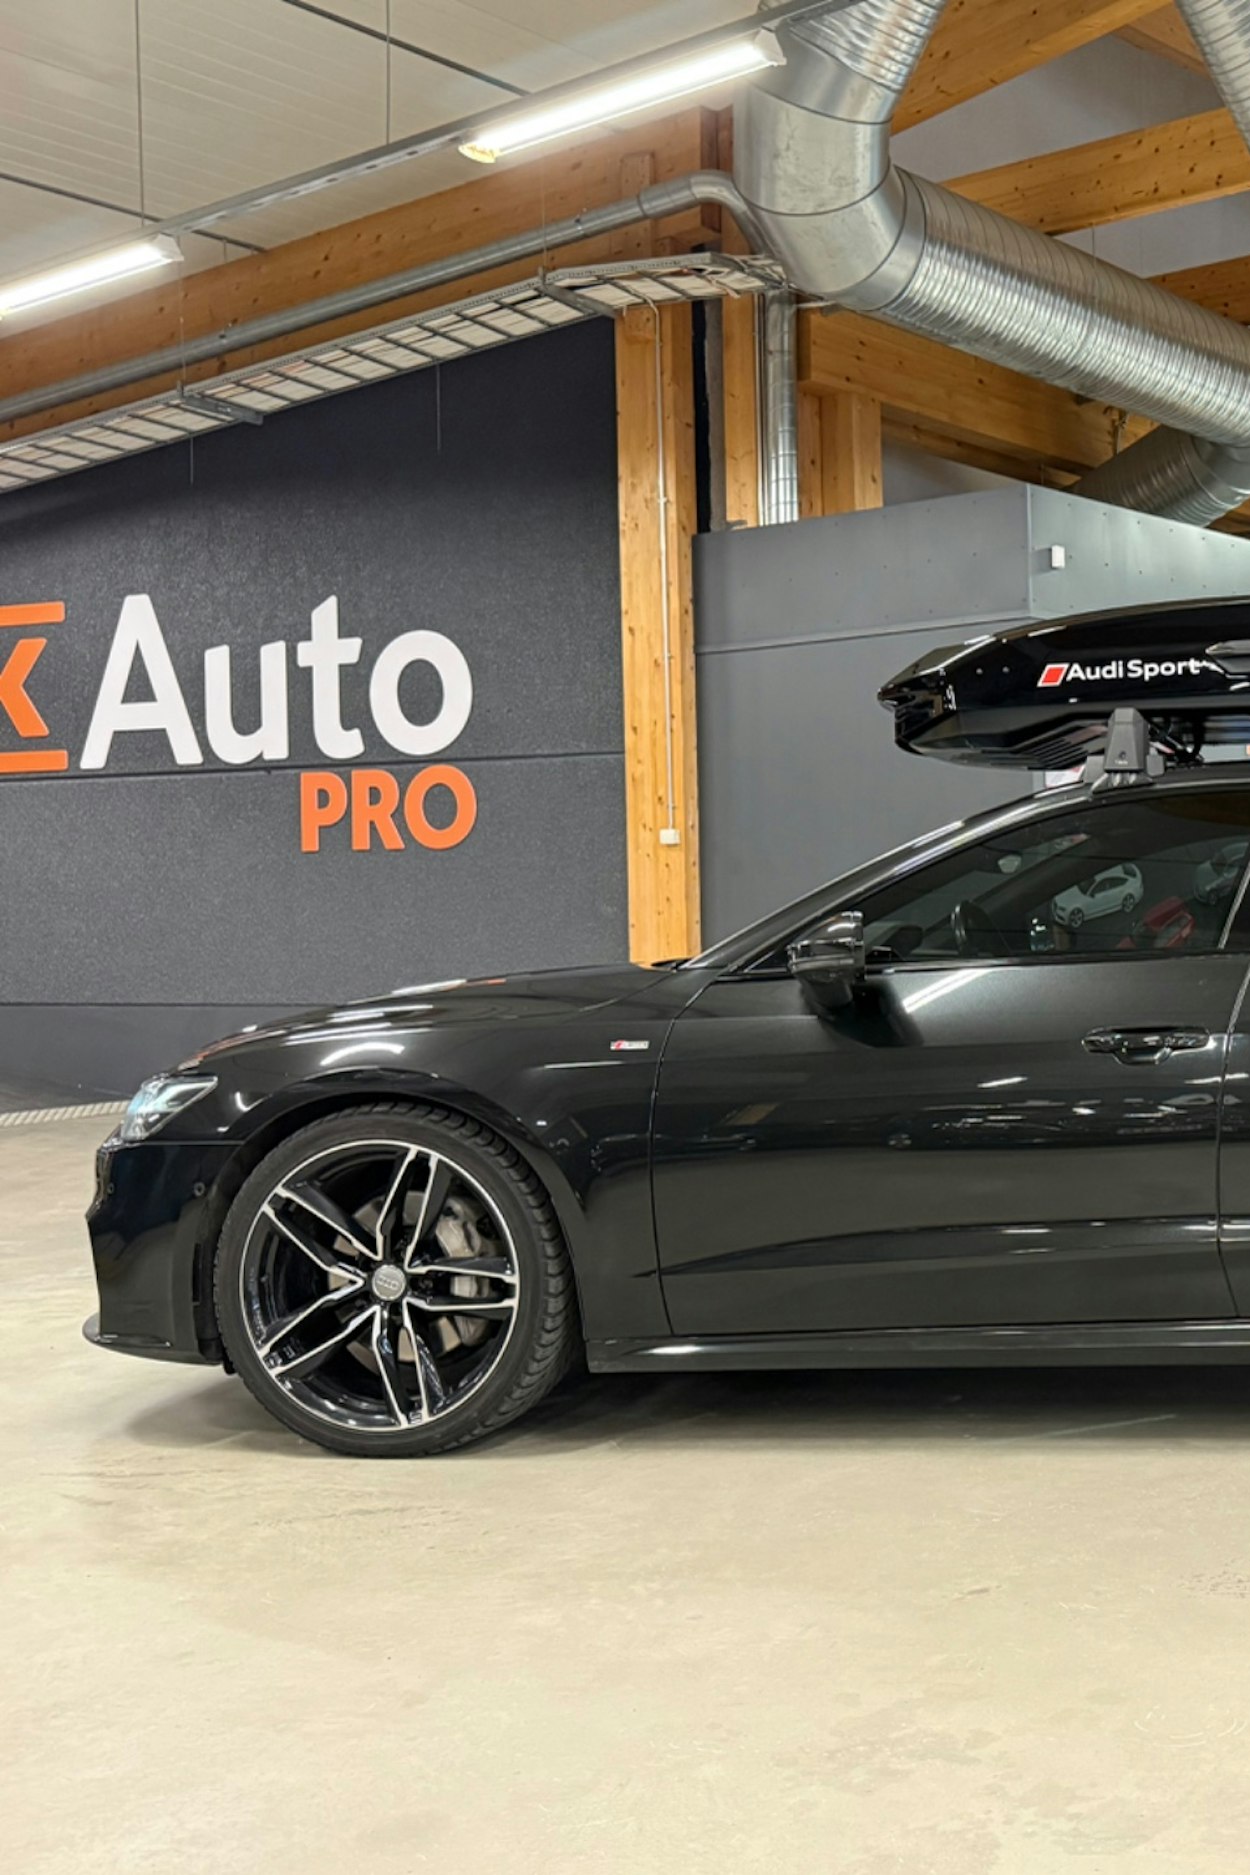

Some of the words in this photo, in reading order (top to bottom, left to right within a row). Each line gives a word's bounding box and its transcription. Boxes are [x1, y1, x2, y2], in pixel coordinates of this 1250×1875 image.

[80, 594, 473, 769] Auto
[1066, 660, 1124, 682] Audi
[1126, 658, 1201, 682] Sport
[300, 765, 477, 852] PRO
